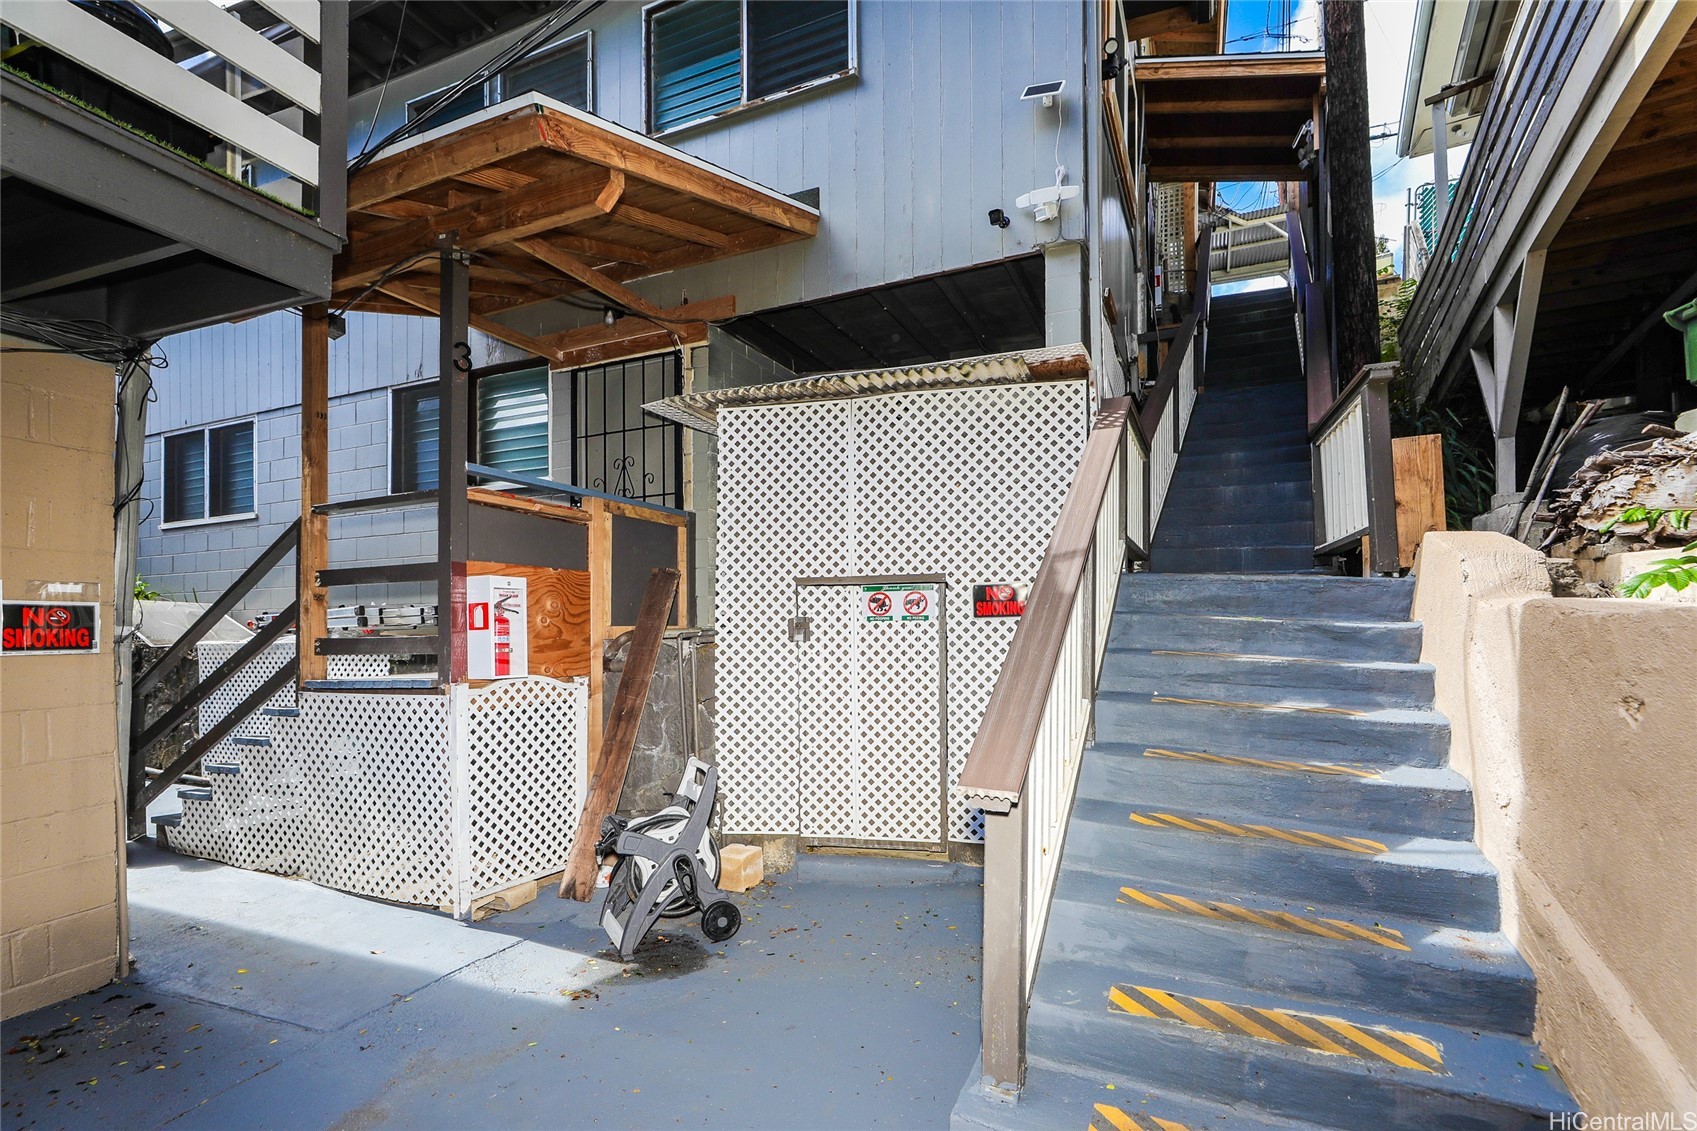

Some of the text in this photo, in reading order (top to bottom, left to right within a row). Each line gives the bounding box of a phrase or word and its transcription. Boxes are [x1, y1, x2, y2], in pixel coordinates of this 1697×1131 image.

[453, 342, 473, 372] 3
[976, 600, 1026, 616] SMOKING
[2, 627, 89, 648] SMOKING
